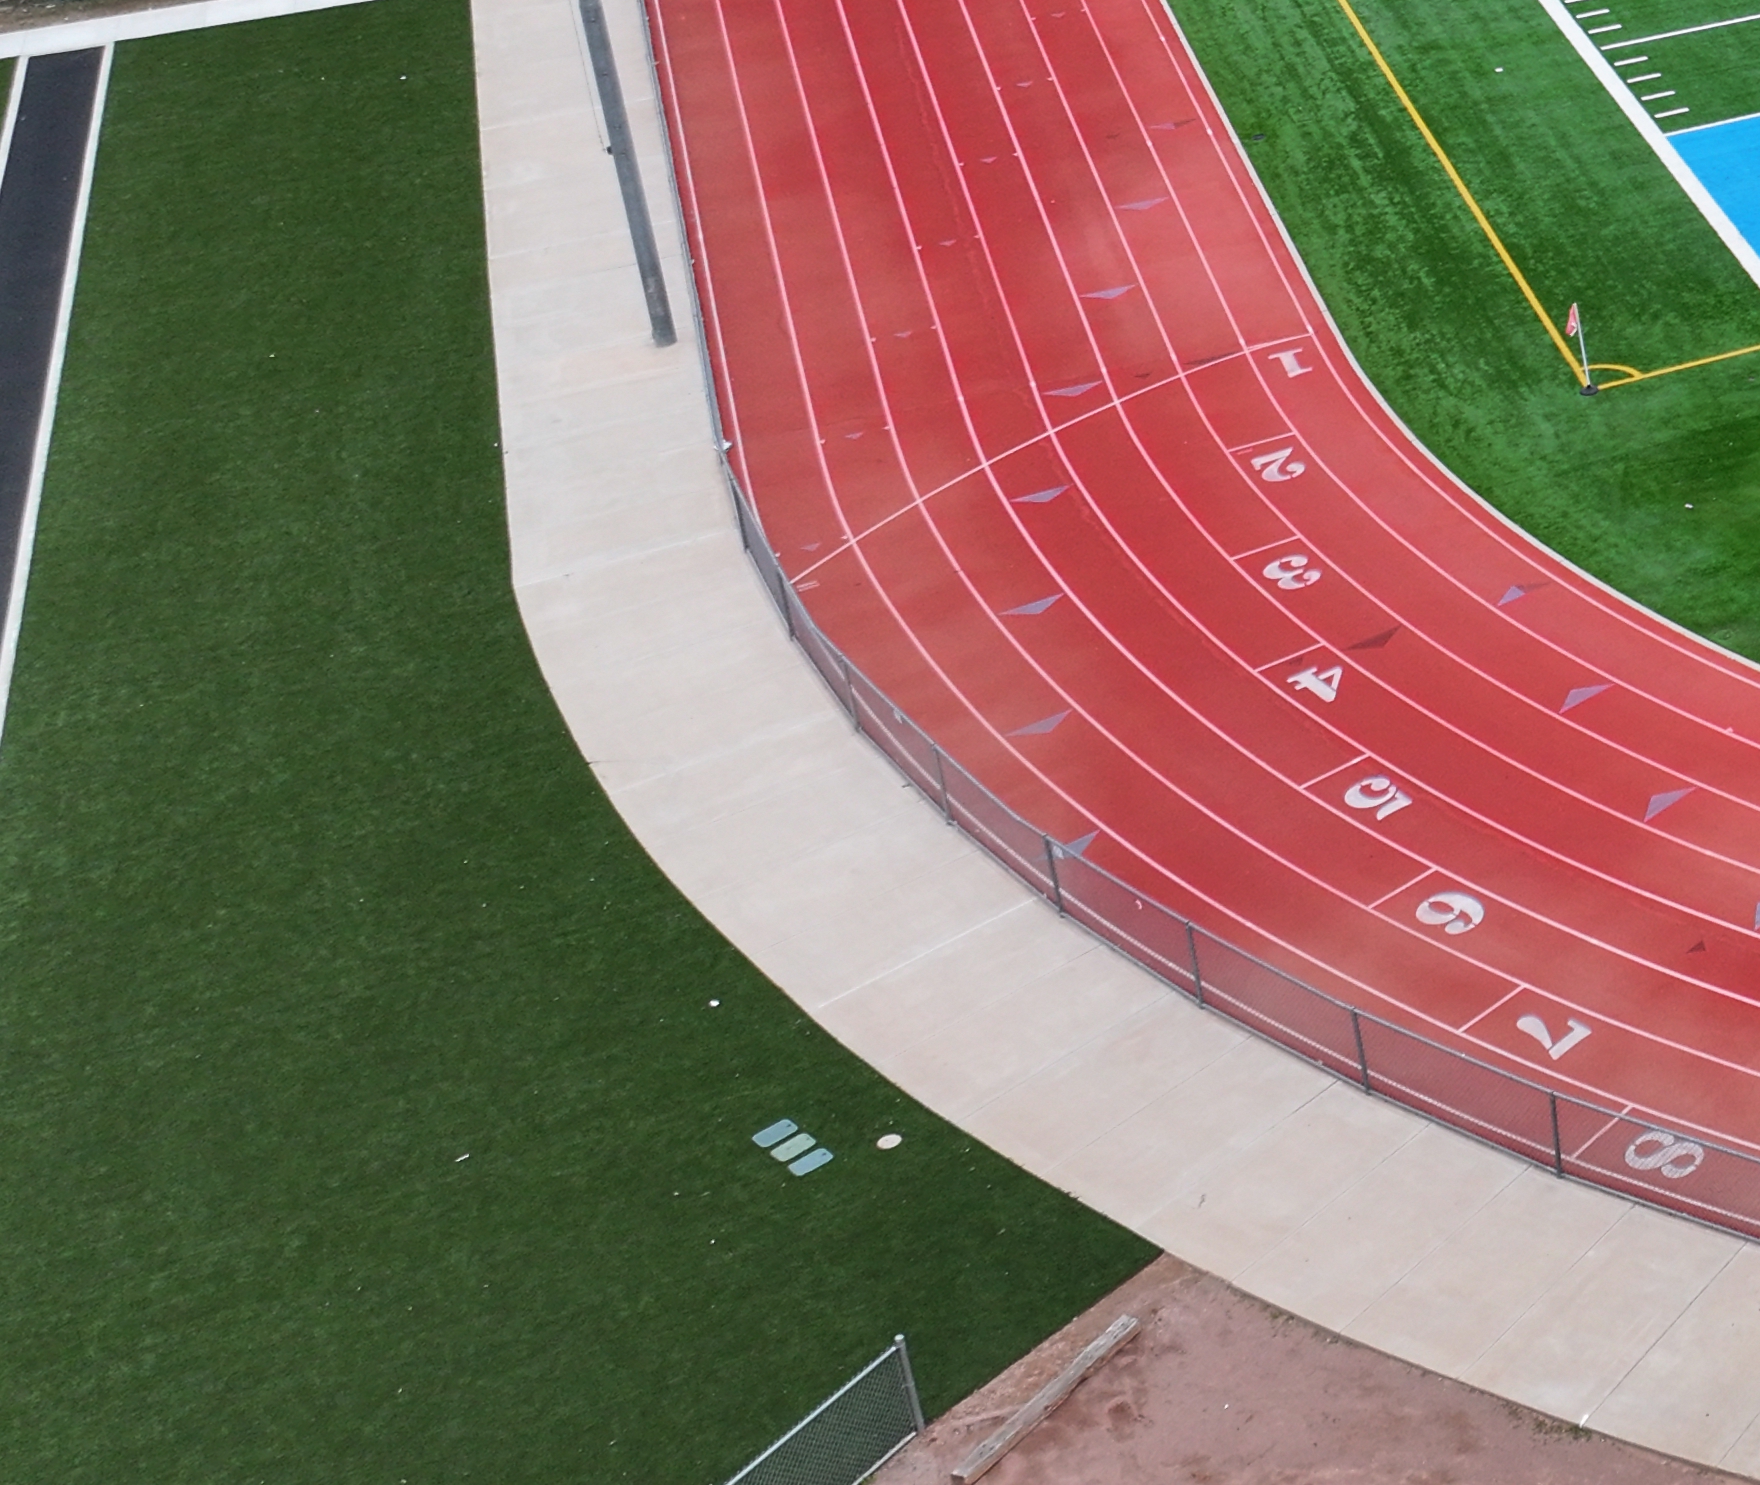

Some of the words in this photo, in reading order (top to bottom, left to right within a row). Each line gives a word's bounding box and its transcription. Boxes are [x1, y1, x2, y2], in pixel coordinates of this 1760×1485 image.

[1268, 347, 1313, 378] 1
[1250, 446, 1306, 482] 2
[1262, 554, 1321, 590] 3
[1286, 666, 1343, 703] 4
[1344, 775, 1413, 821] 5
[1415, 891, 1485, 935] 6
[1516, 1014, 1592, 1060] 7
[1625, 1131, 1704, 1178] 8
